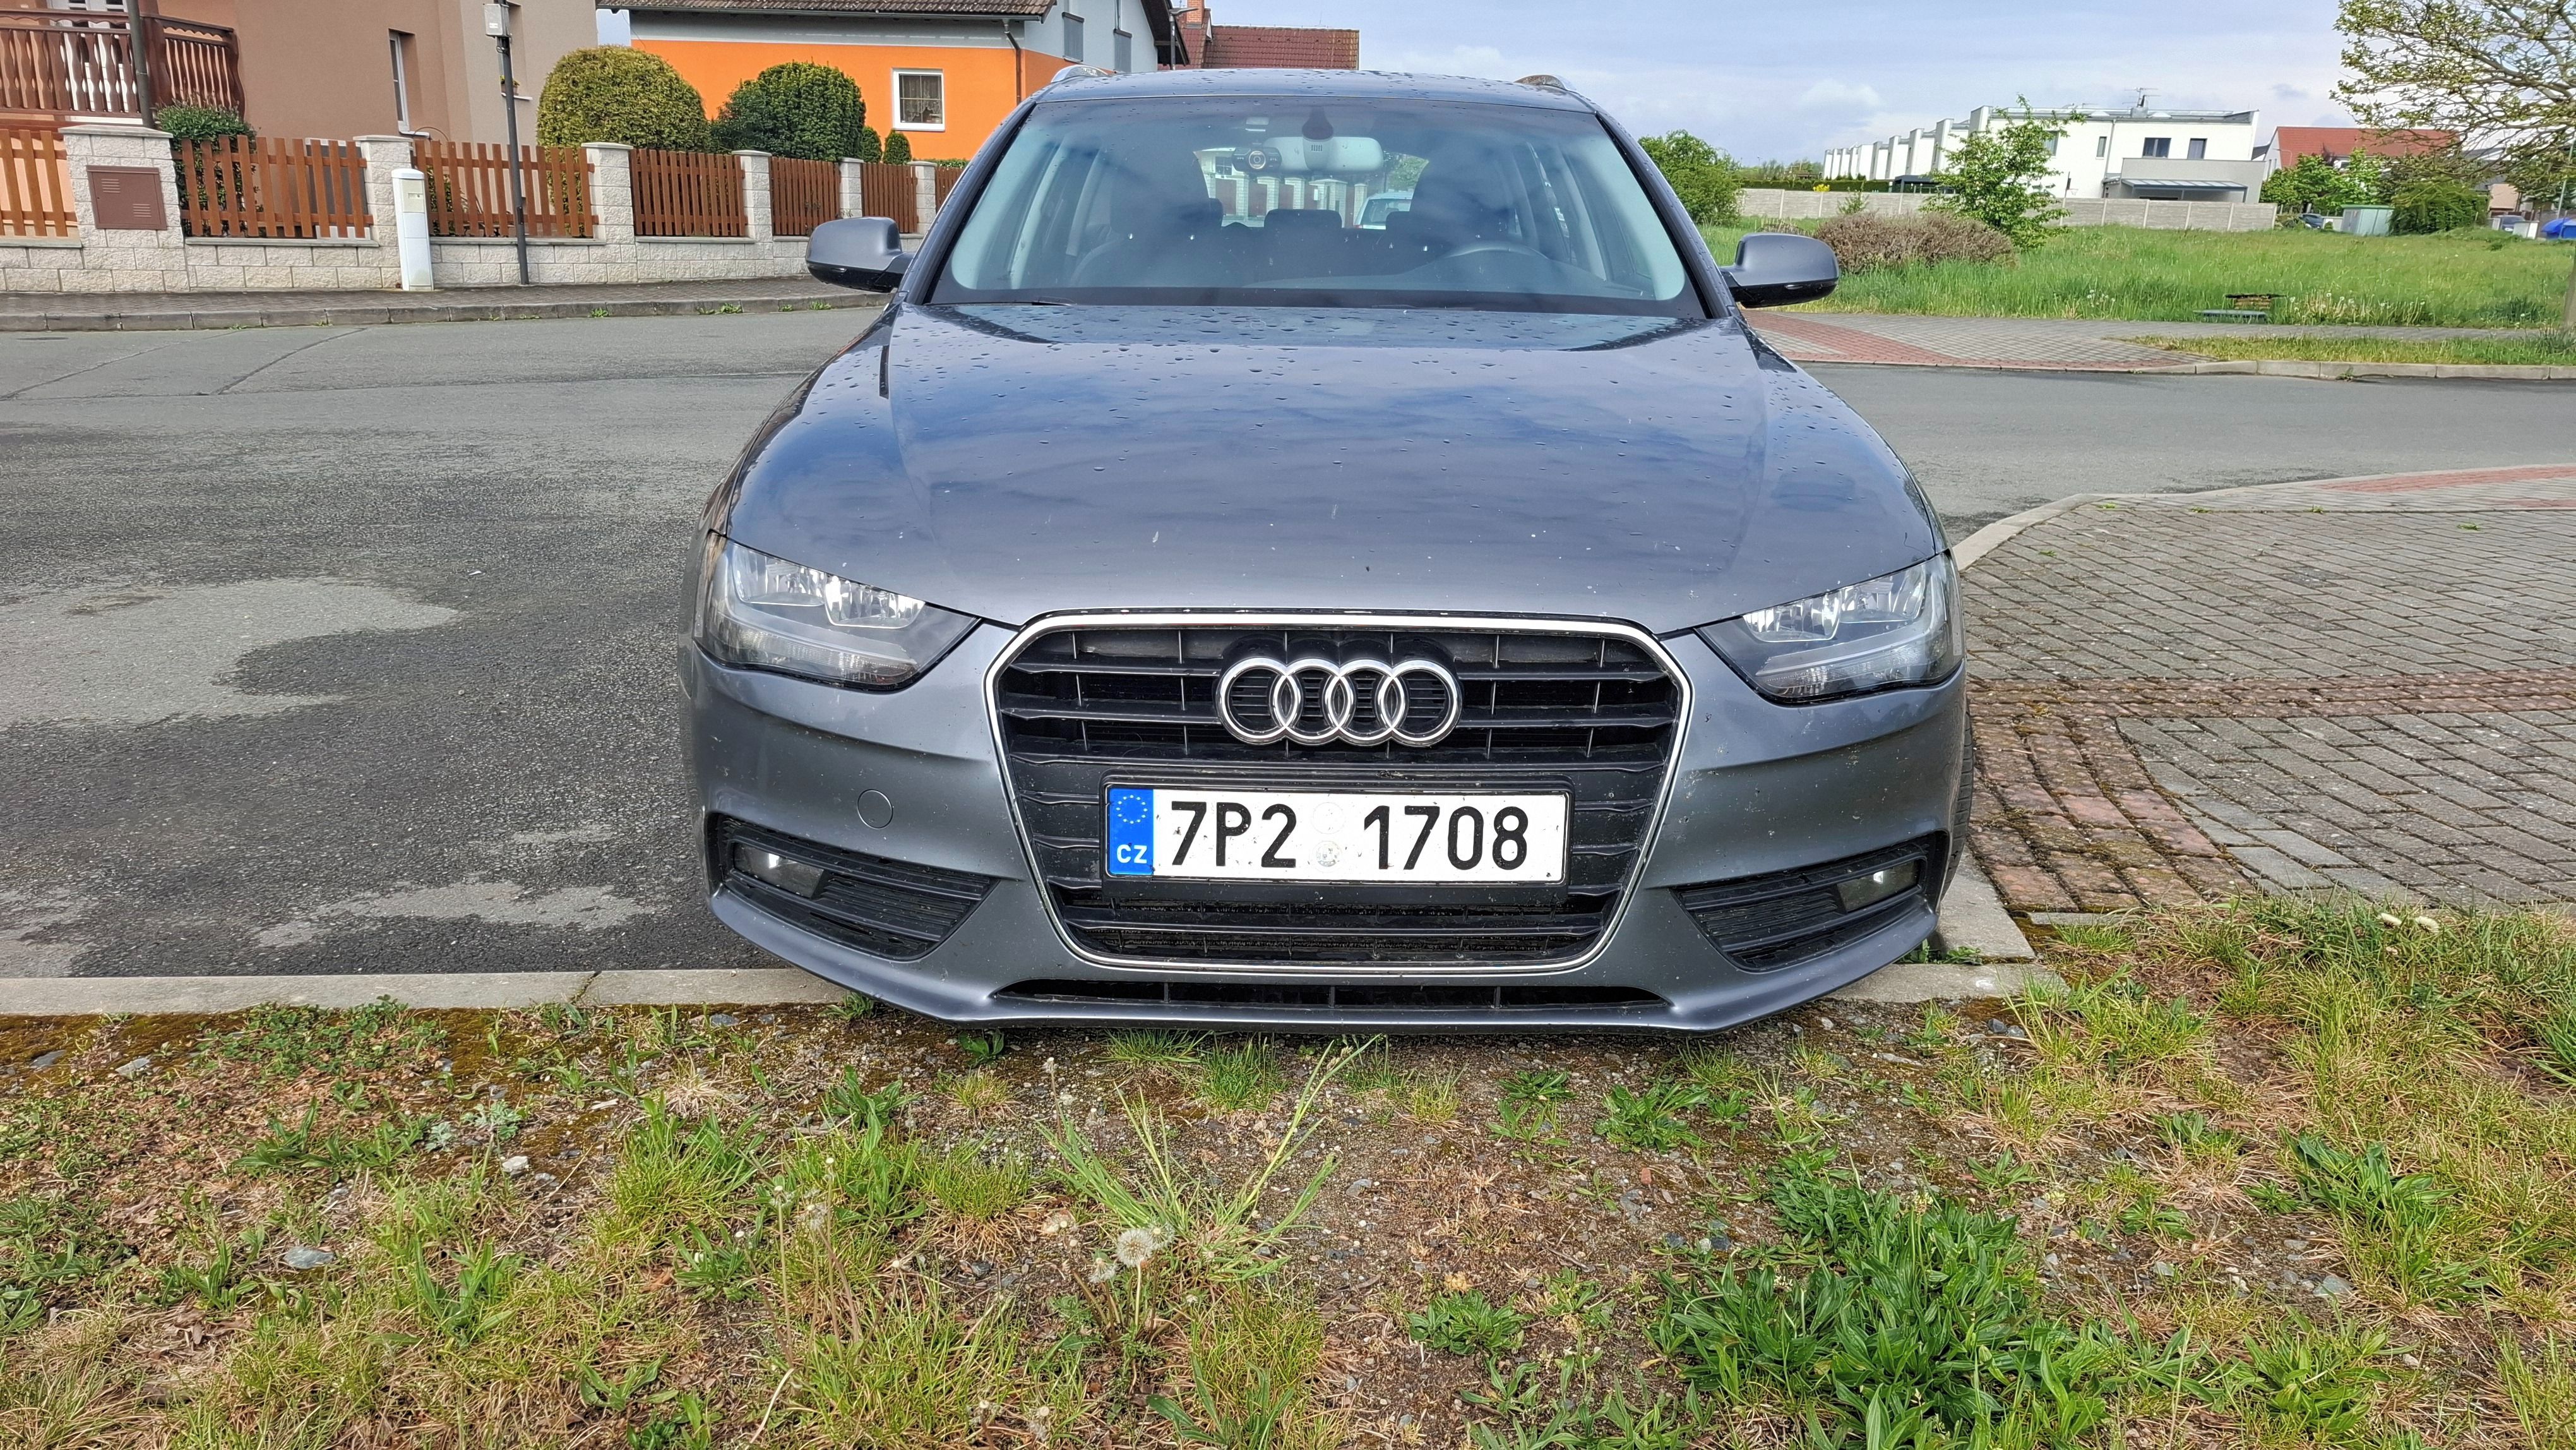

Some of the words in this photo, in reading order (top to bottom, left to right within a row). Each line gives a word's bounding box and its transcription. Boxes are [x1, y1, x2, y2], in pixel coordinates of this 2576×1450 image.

[1116, 844, 1147, 864] CZ
[1171, 801, 1297, 868] 7P2
[1364, 805, 1529, 870] 1708
